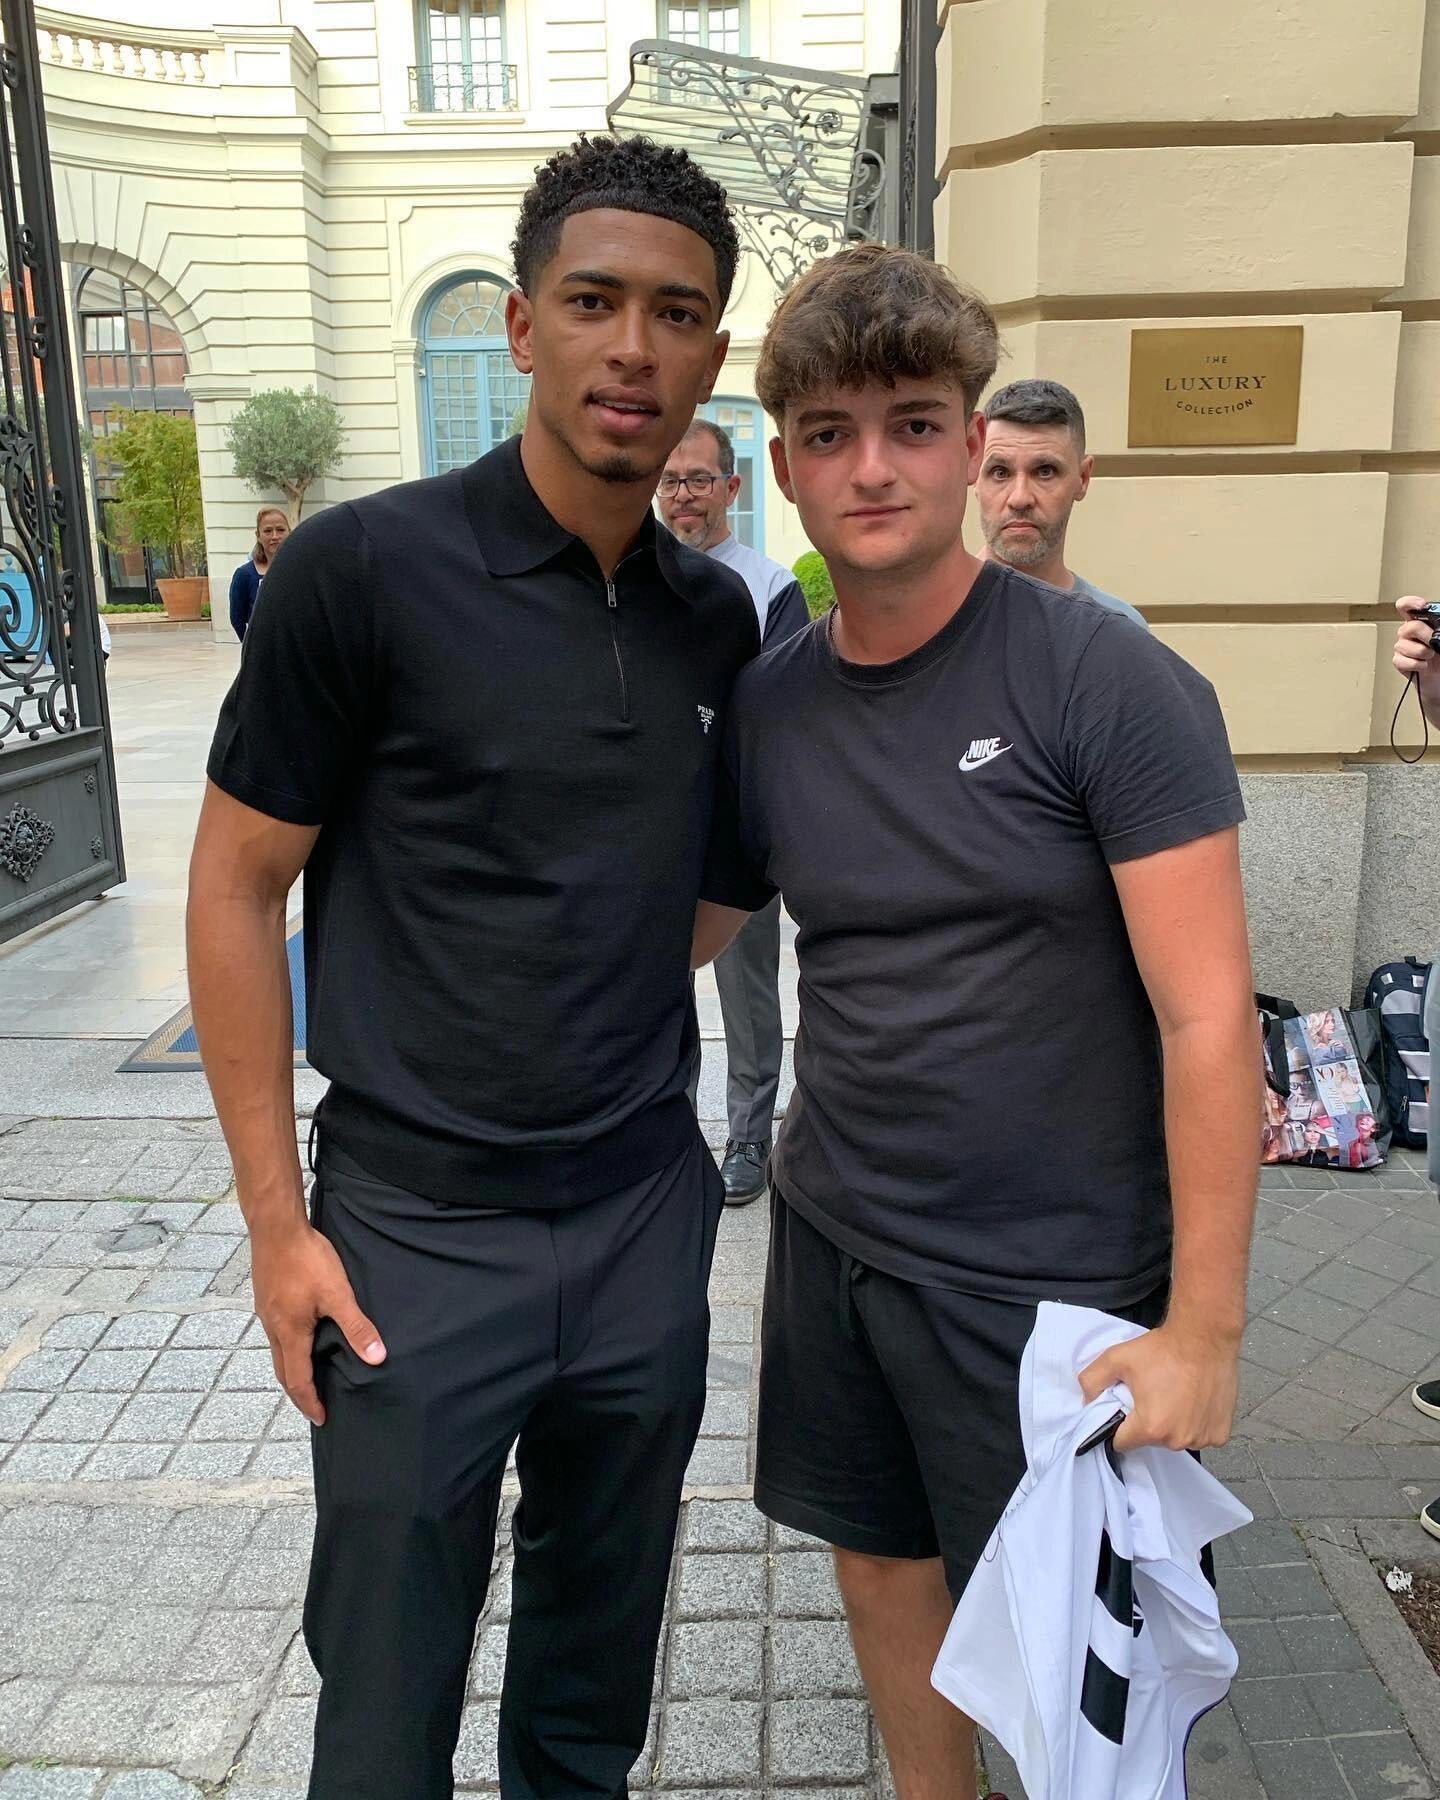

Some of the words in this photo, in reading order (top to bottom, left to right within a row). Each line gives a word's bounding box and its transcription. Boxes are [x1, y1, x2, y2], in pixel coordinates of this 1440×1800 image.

[1205, 355, 1229, 365] THE
[1164, 375, 1267, 392] LUXURY
[1176, 398, 1254, 415] COLLECTION
[966, 736, 1001, 760] NIKE
